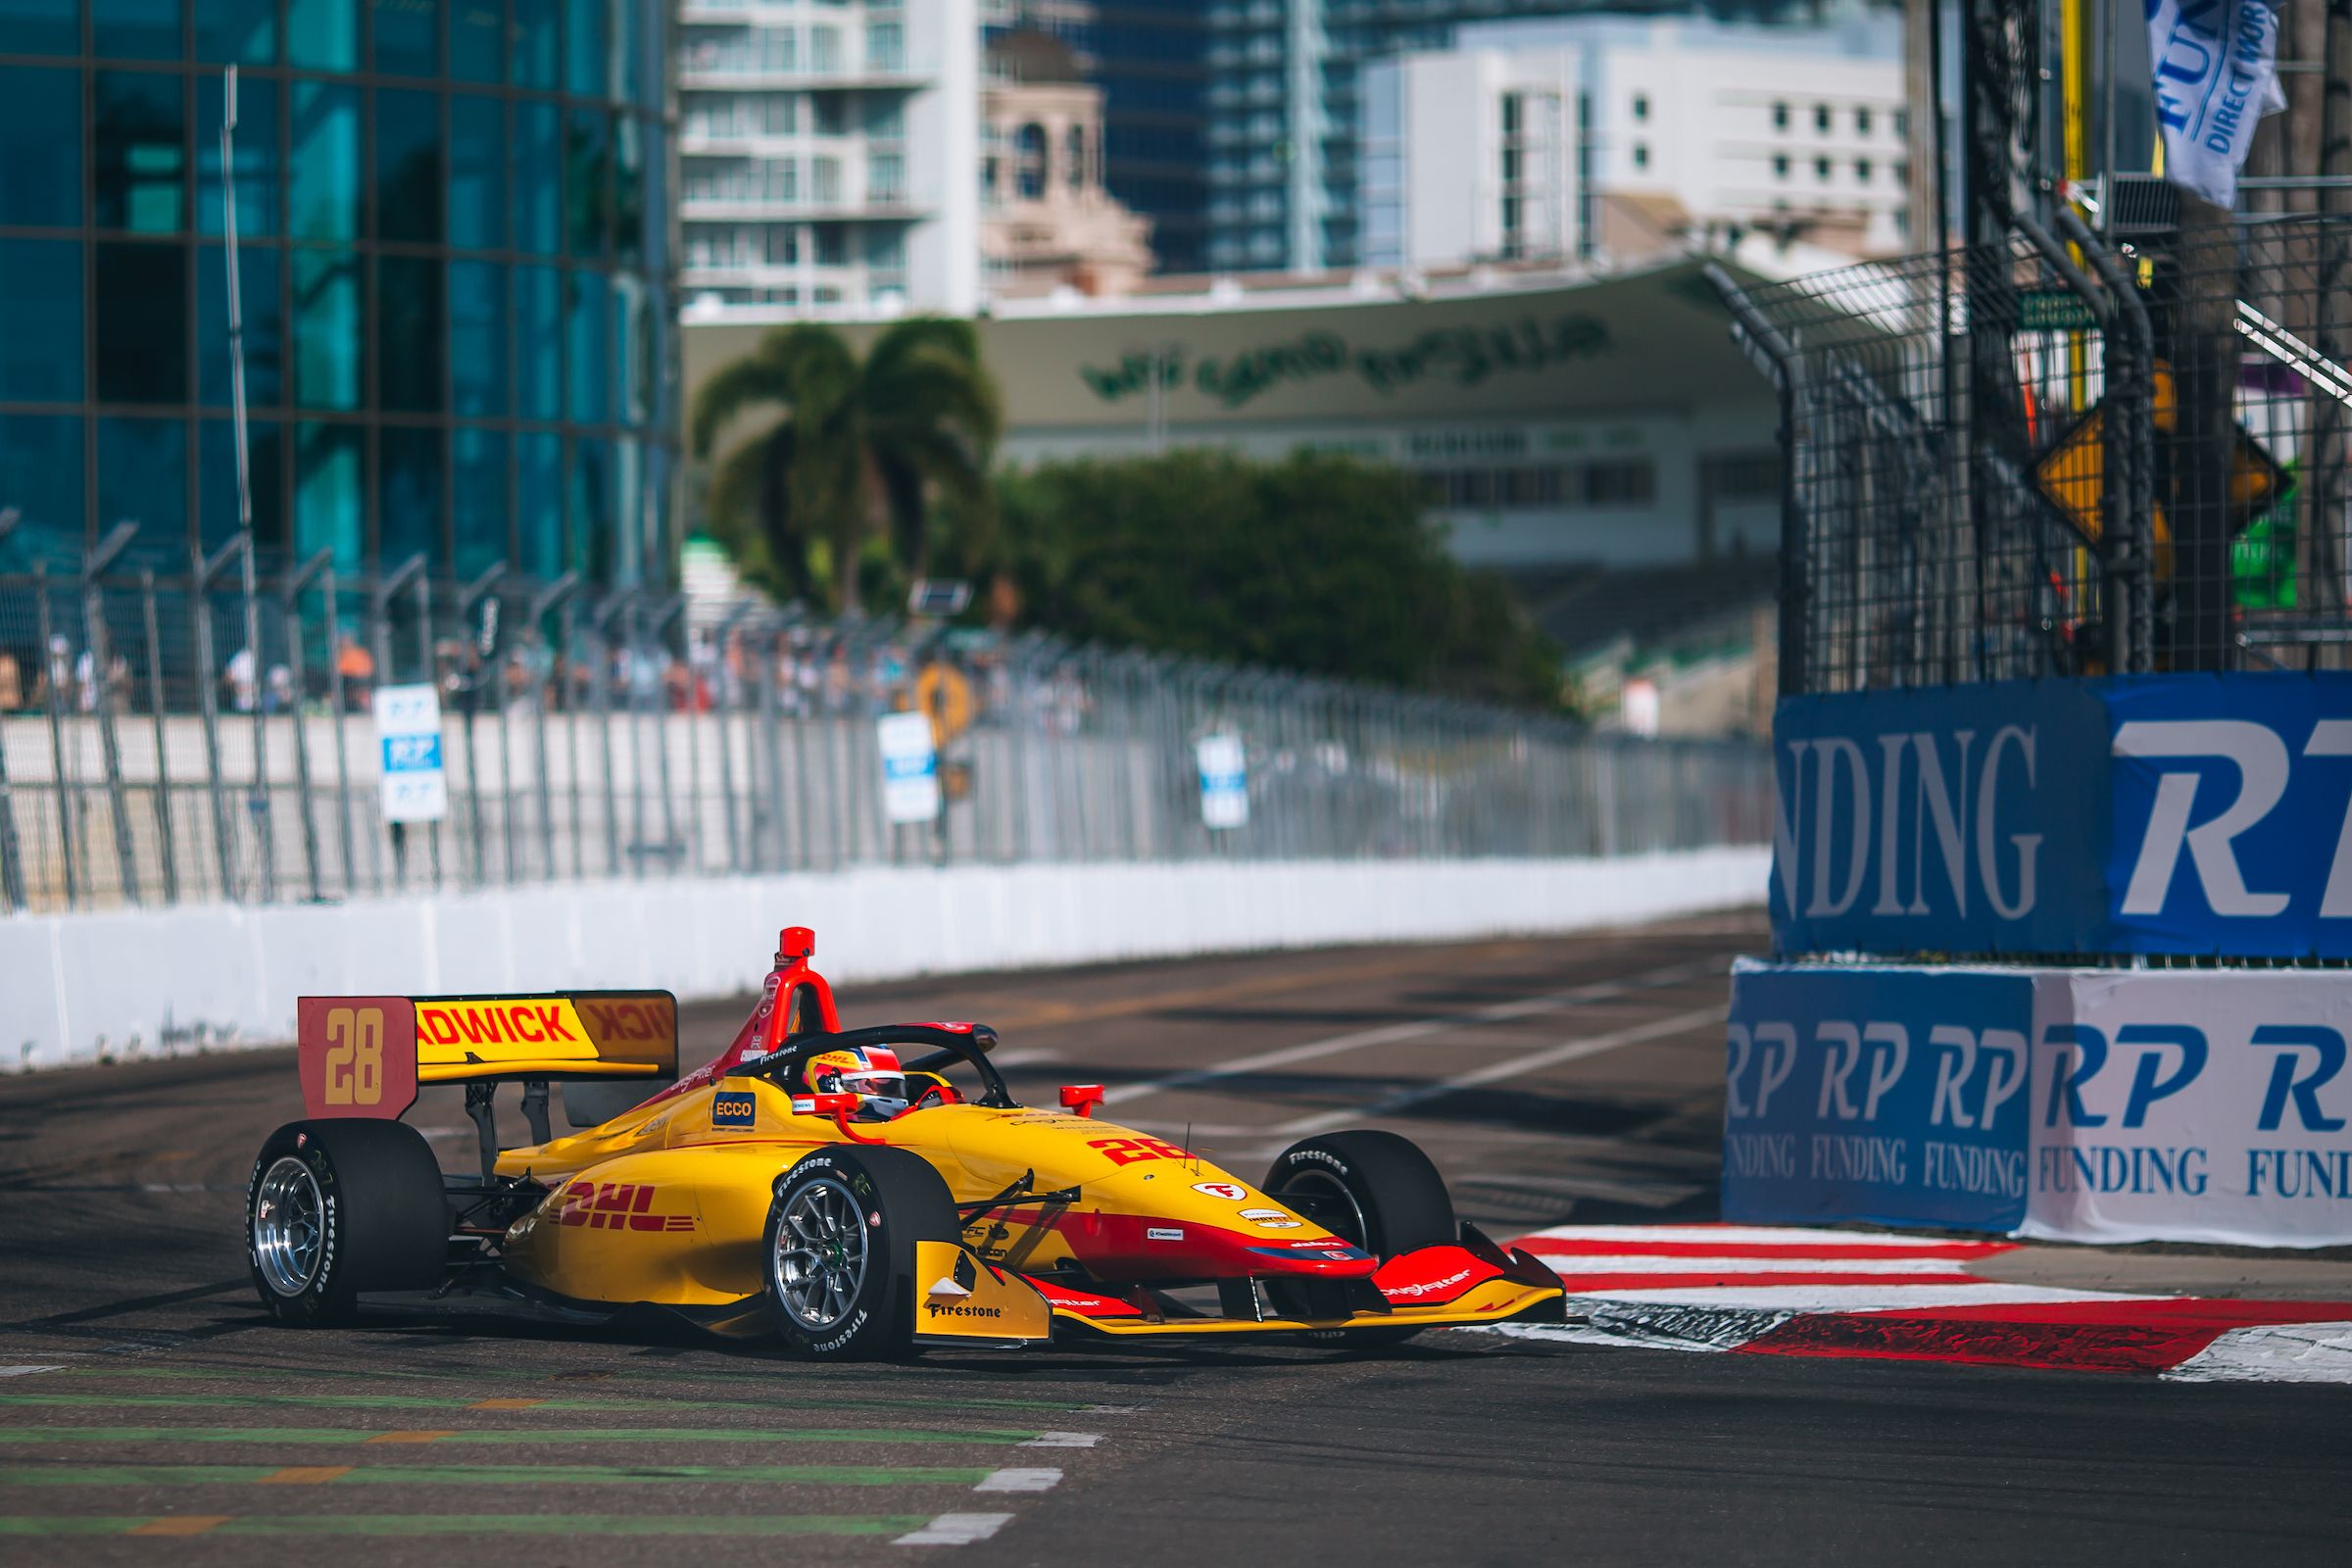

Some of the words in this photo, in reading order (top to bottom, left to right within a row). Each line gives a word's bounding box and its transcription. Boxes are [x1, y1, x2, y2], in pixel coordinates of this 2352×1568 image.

[325, 1007, 383, 1105] 28
[1815, 1020, 1909, 1121] RP
[1928, 1024, 2029, 1132] RP
[2042, 1024, 2209, 1129] RP
[2250, 1025, 2347, 1133] R
[716, 1102, 753, 1117] ECCO
[778, 1156, 831, 1199] Firestone
[1289, 1150, 1348, 1176] Firestone
[1811, 1133, 1906, 1186] FUNDING
[1923, 1141, 2026, 1198] FUNDING
[2038, 1146, 2209, 1197] FUNDING
[560, 1182, 667, 1232] DHL
[316, 1194, 337, 1294] Firestone
[813, 1307, 868, 1352] Firestone
[927, 1302, 1002, 1318] Firestone
